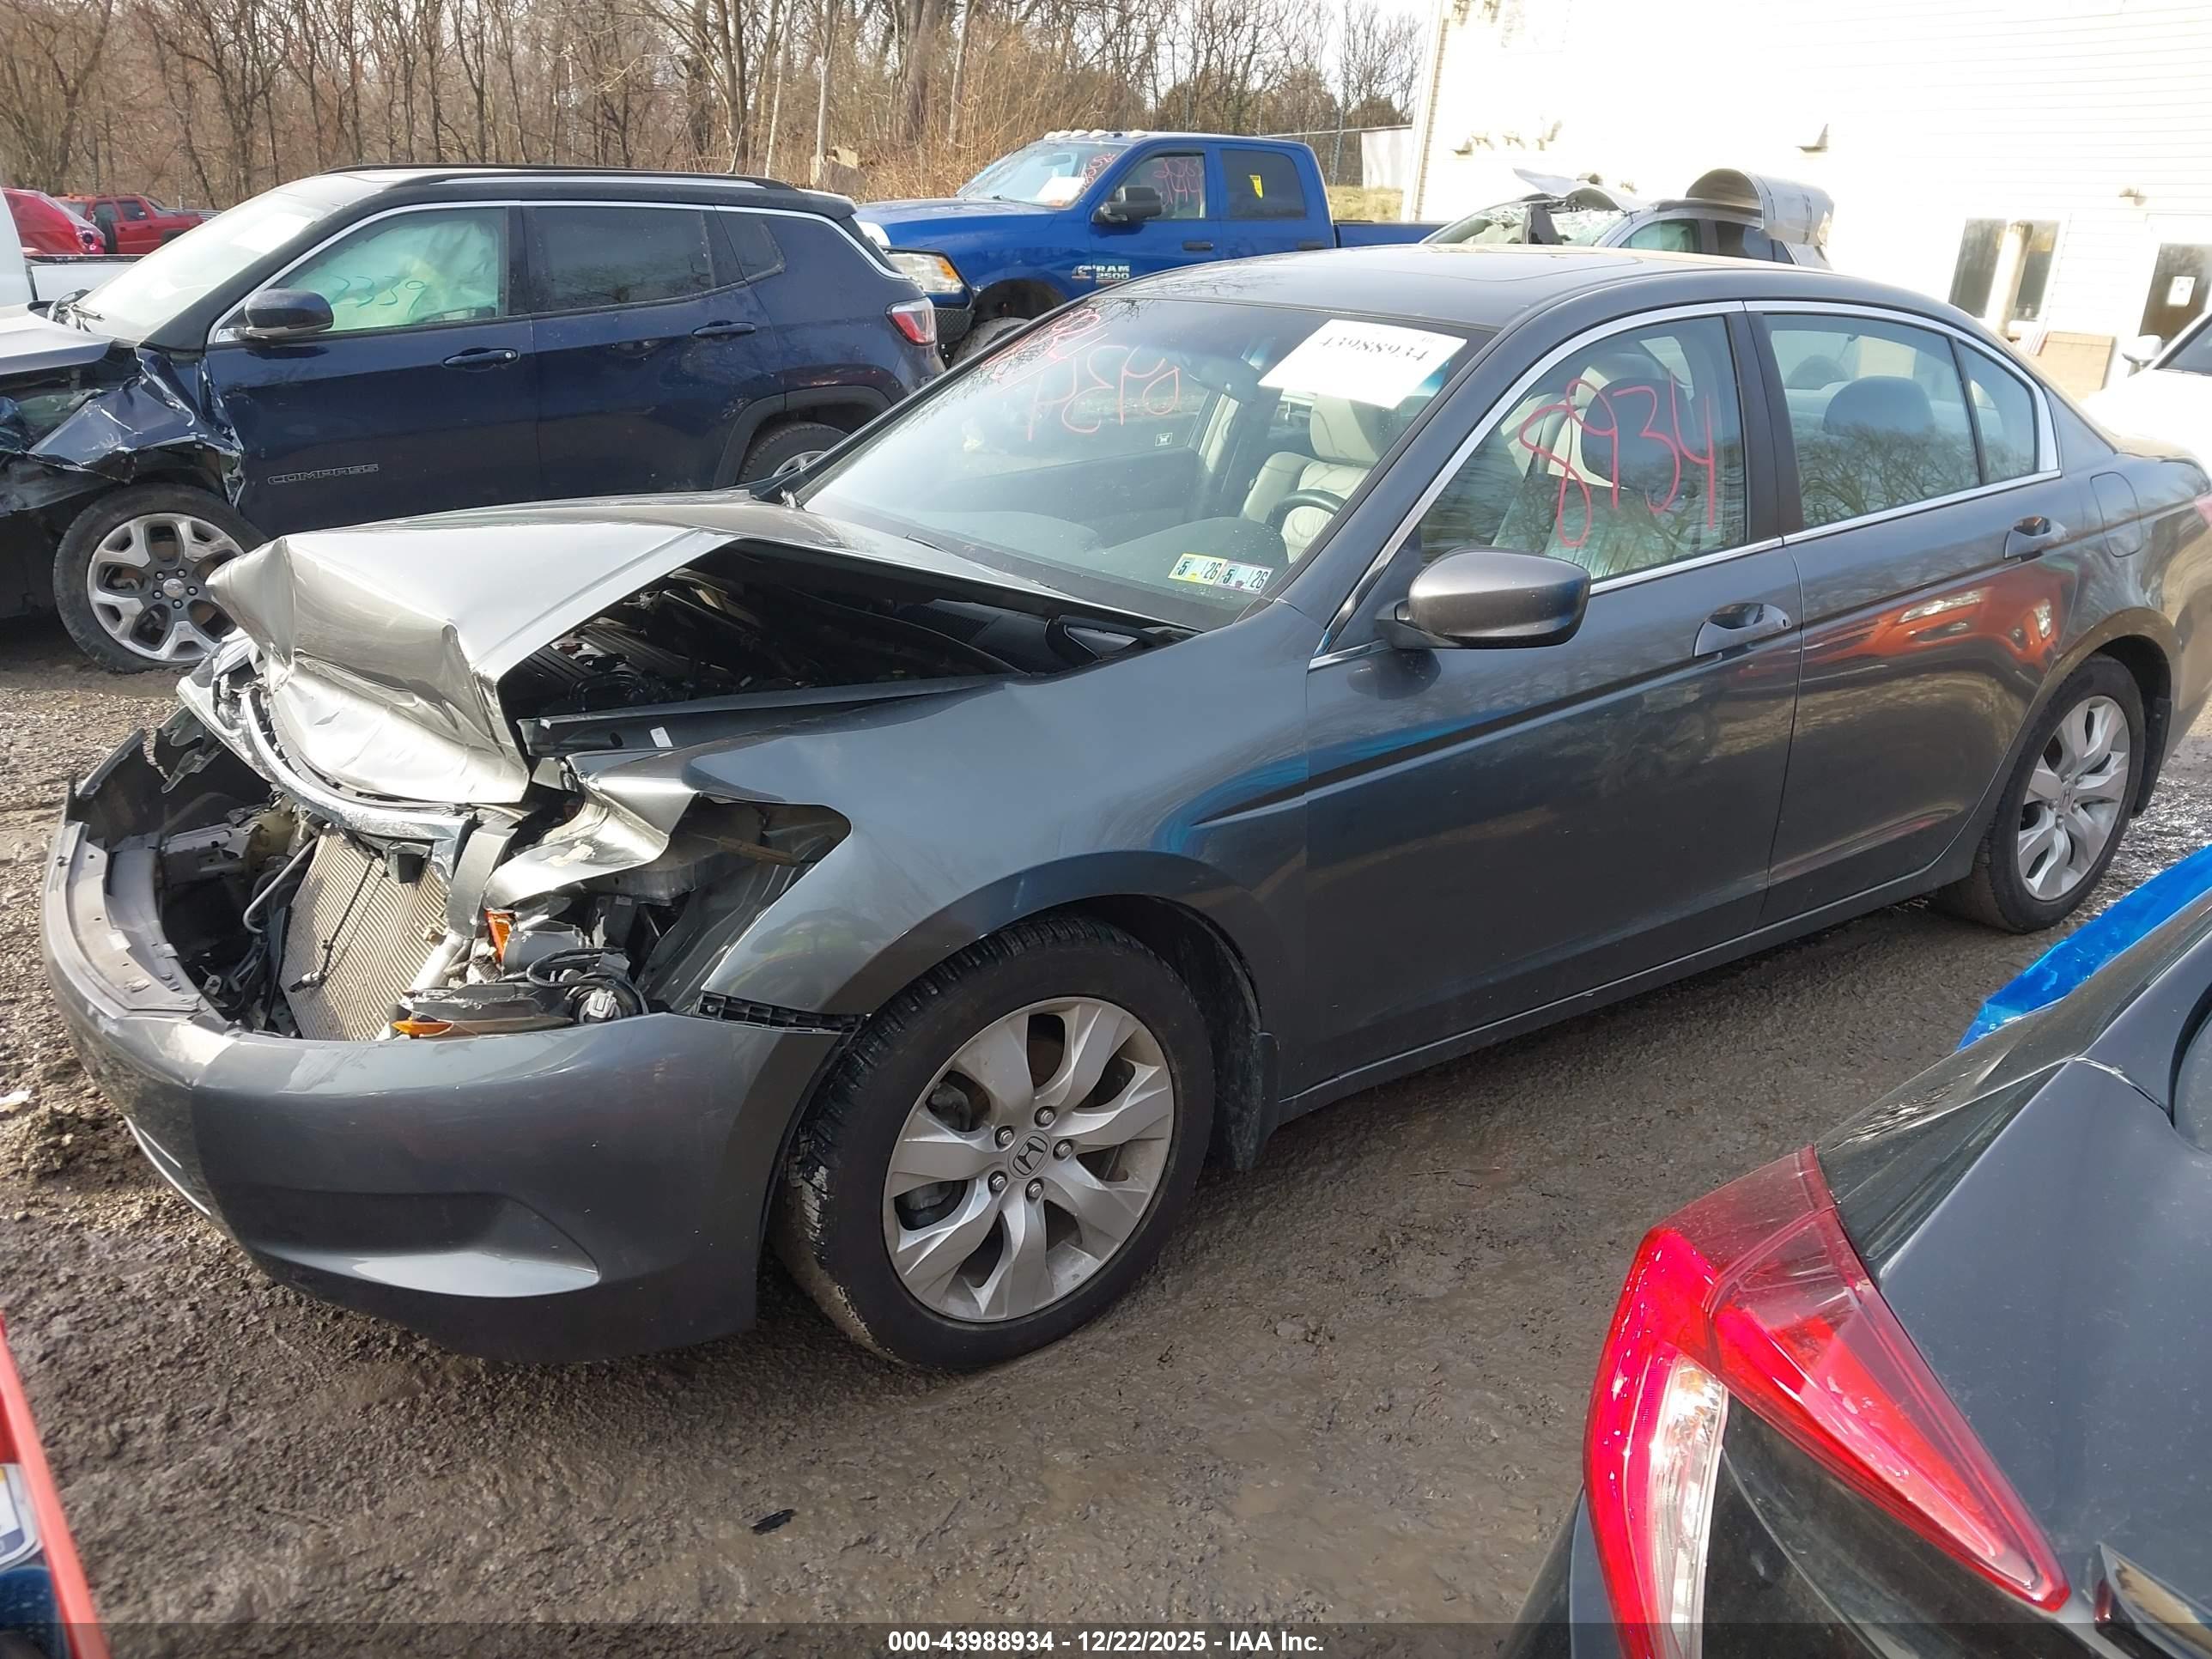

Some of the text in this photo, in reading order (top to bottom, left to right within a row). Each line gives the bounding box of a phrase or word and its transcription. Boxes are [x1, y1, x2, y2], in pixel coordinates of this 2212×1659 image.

[1096, 264, 1130, 273] RAM
[1518, 368, 1716, 548] 8934
[267, 464, 379, 485] COMPASS
[1177, 561, 1223, 580] 5 26
[1223, 568, 1268, 589] 5 26
